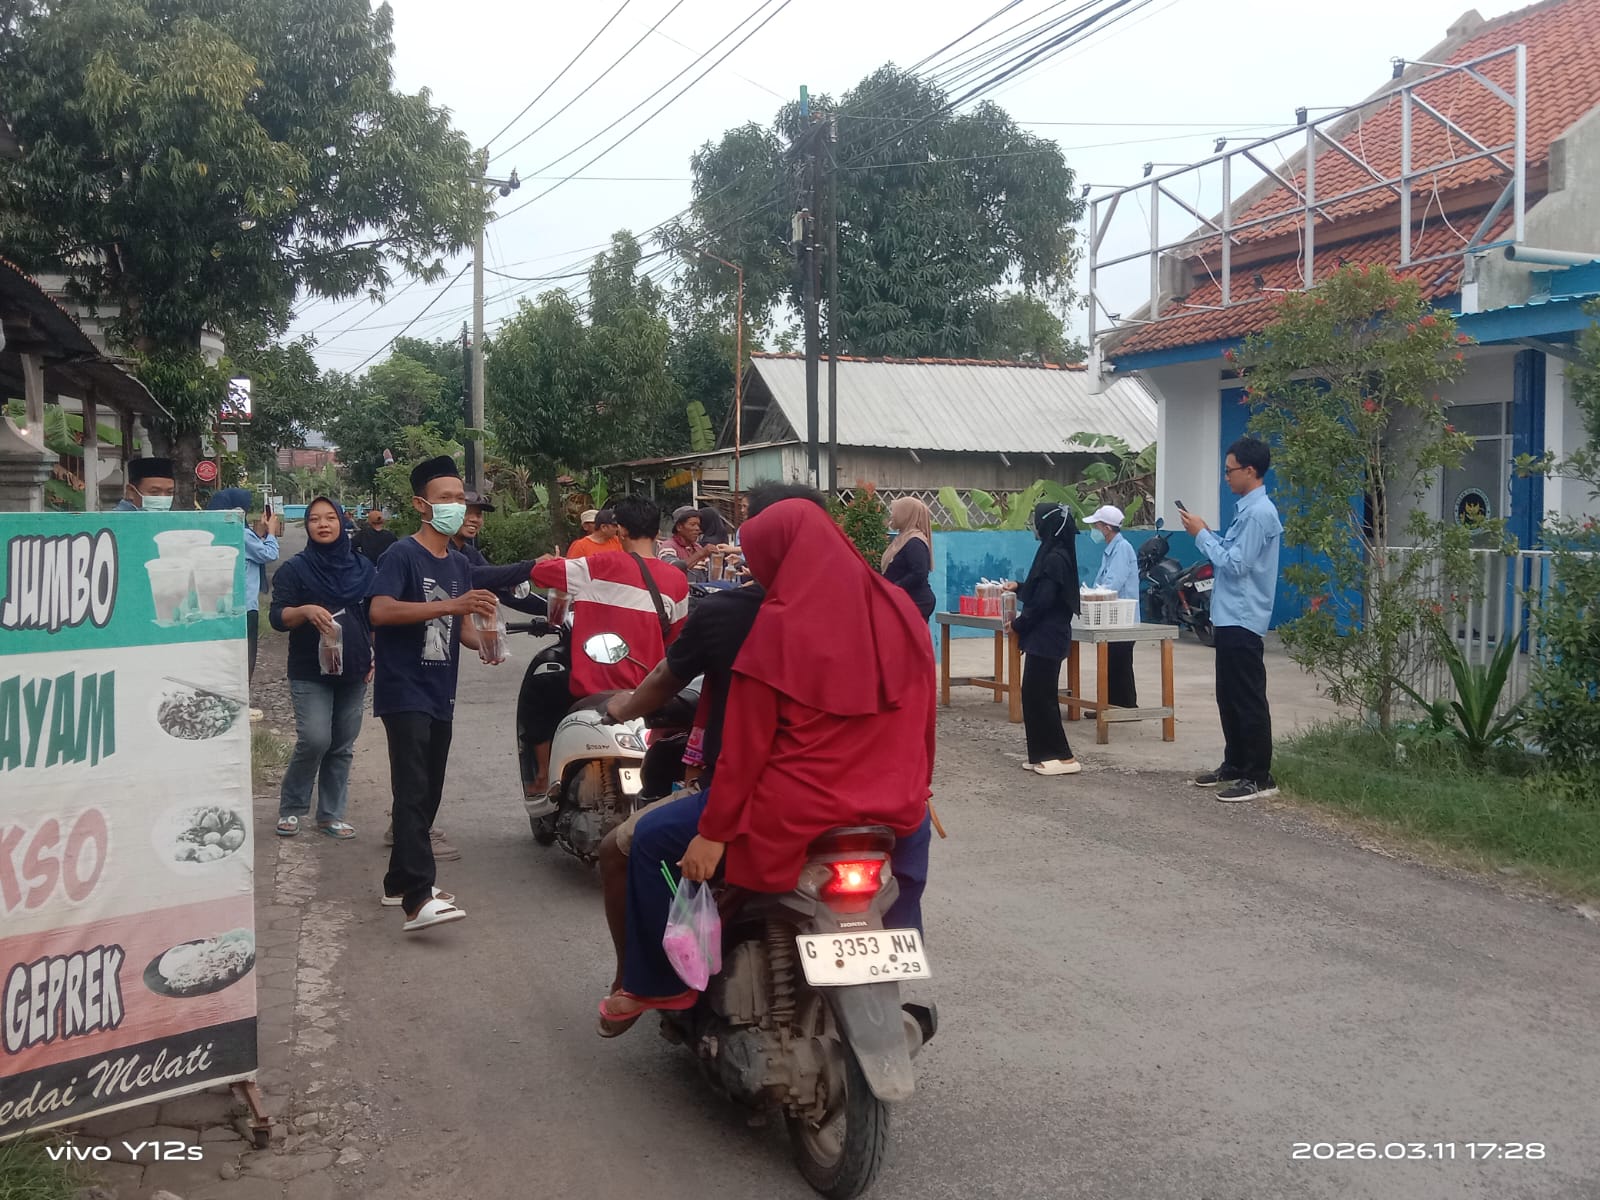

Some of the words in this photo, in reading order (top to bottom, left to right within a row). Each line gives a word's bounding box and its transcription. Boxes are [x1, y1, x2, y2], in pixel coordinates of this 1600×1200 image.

[2, 530, 116, 631] JUMBO
[0, 670, 115, 772] AYAM
[624, 770, 631, 780] G
[805, 940, 817, 959] G
[832, 936, 880, 958] 3353
[891, 934, 917, 953] NW
[4, 946, 123, 1053] GEPREK
[87, 1042, 213, 1098] Melati
